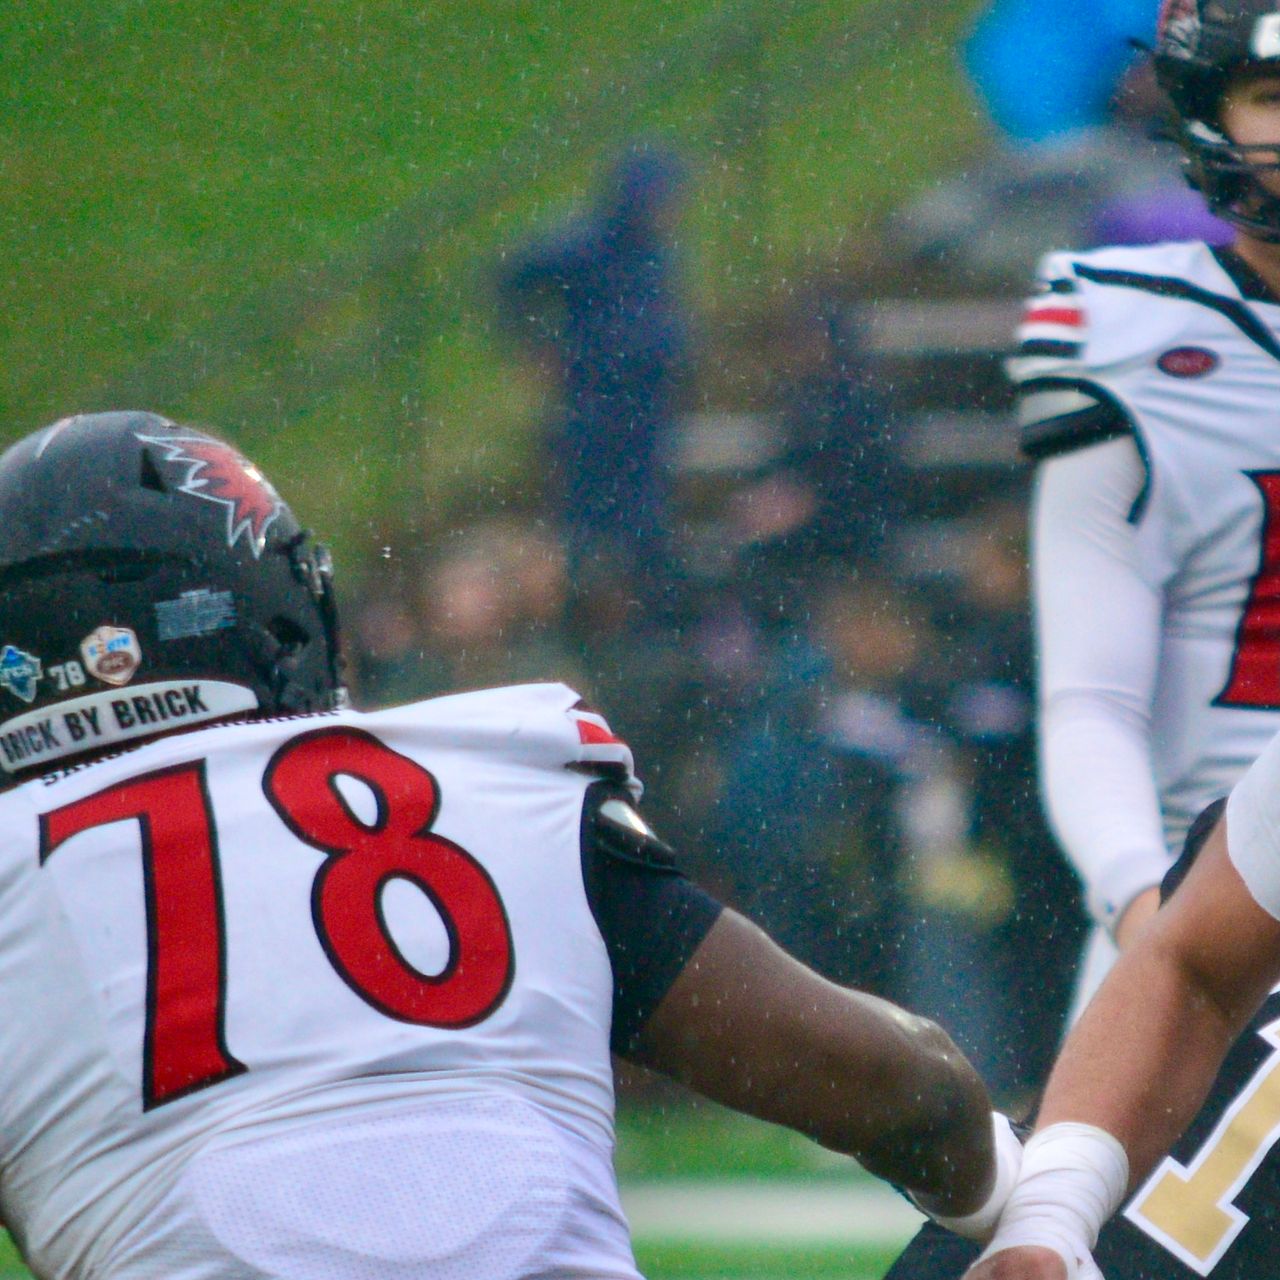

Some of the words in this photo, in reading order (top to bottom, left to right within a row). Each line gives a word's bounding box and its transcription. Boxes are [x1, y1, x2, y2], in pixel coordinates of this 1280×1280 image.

[48, 661, 85, 690] 78
[63, 705, 102, 742] BY
[111, 685, 210, 730] BRICK
[38, 725, 517, 1113] 78
